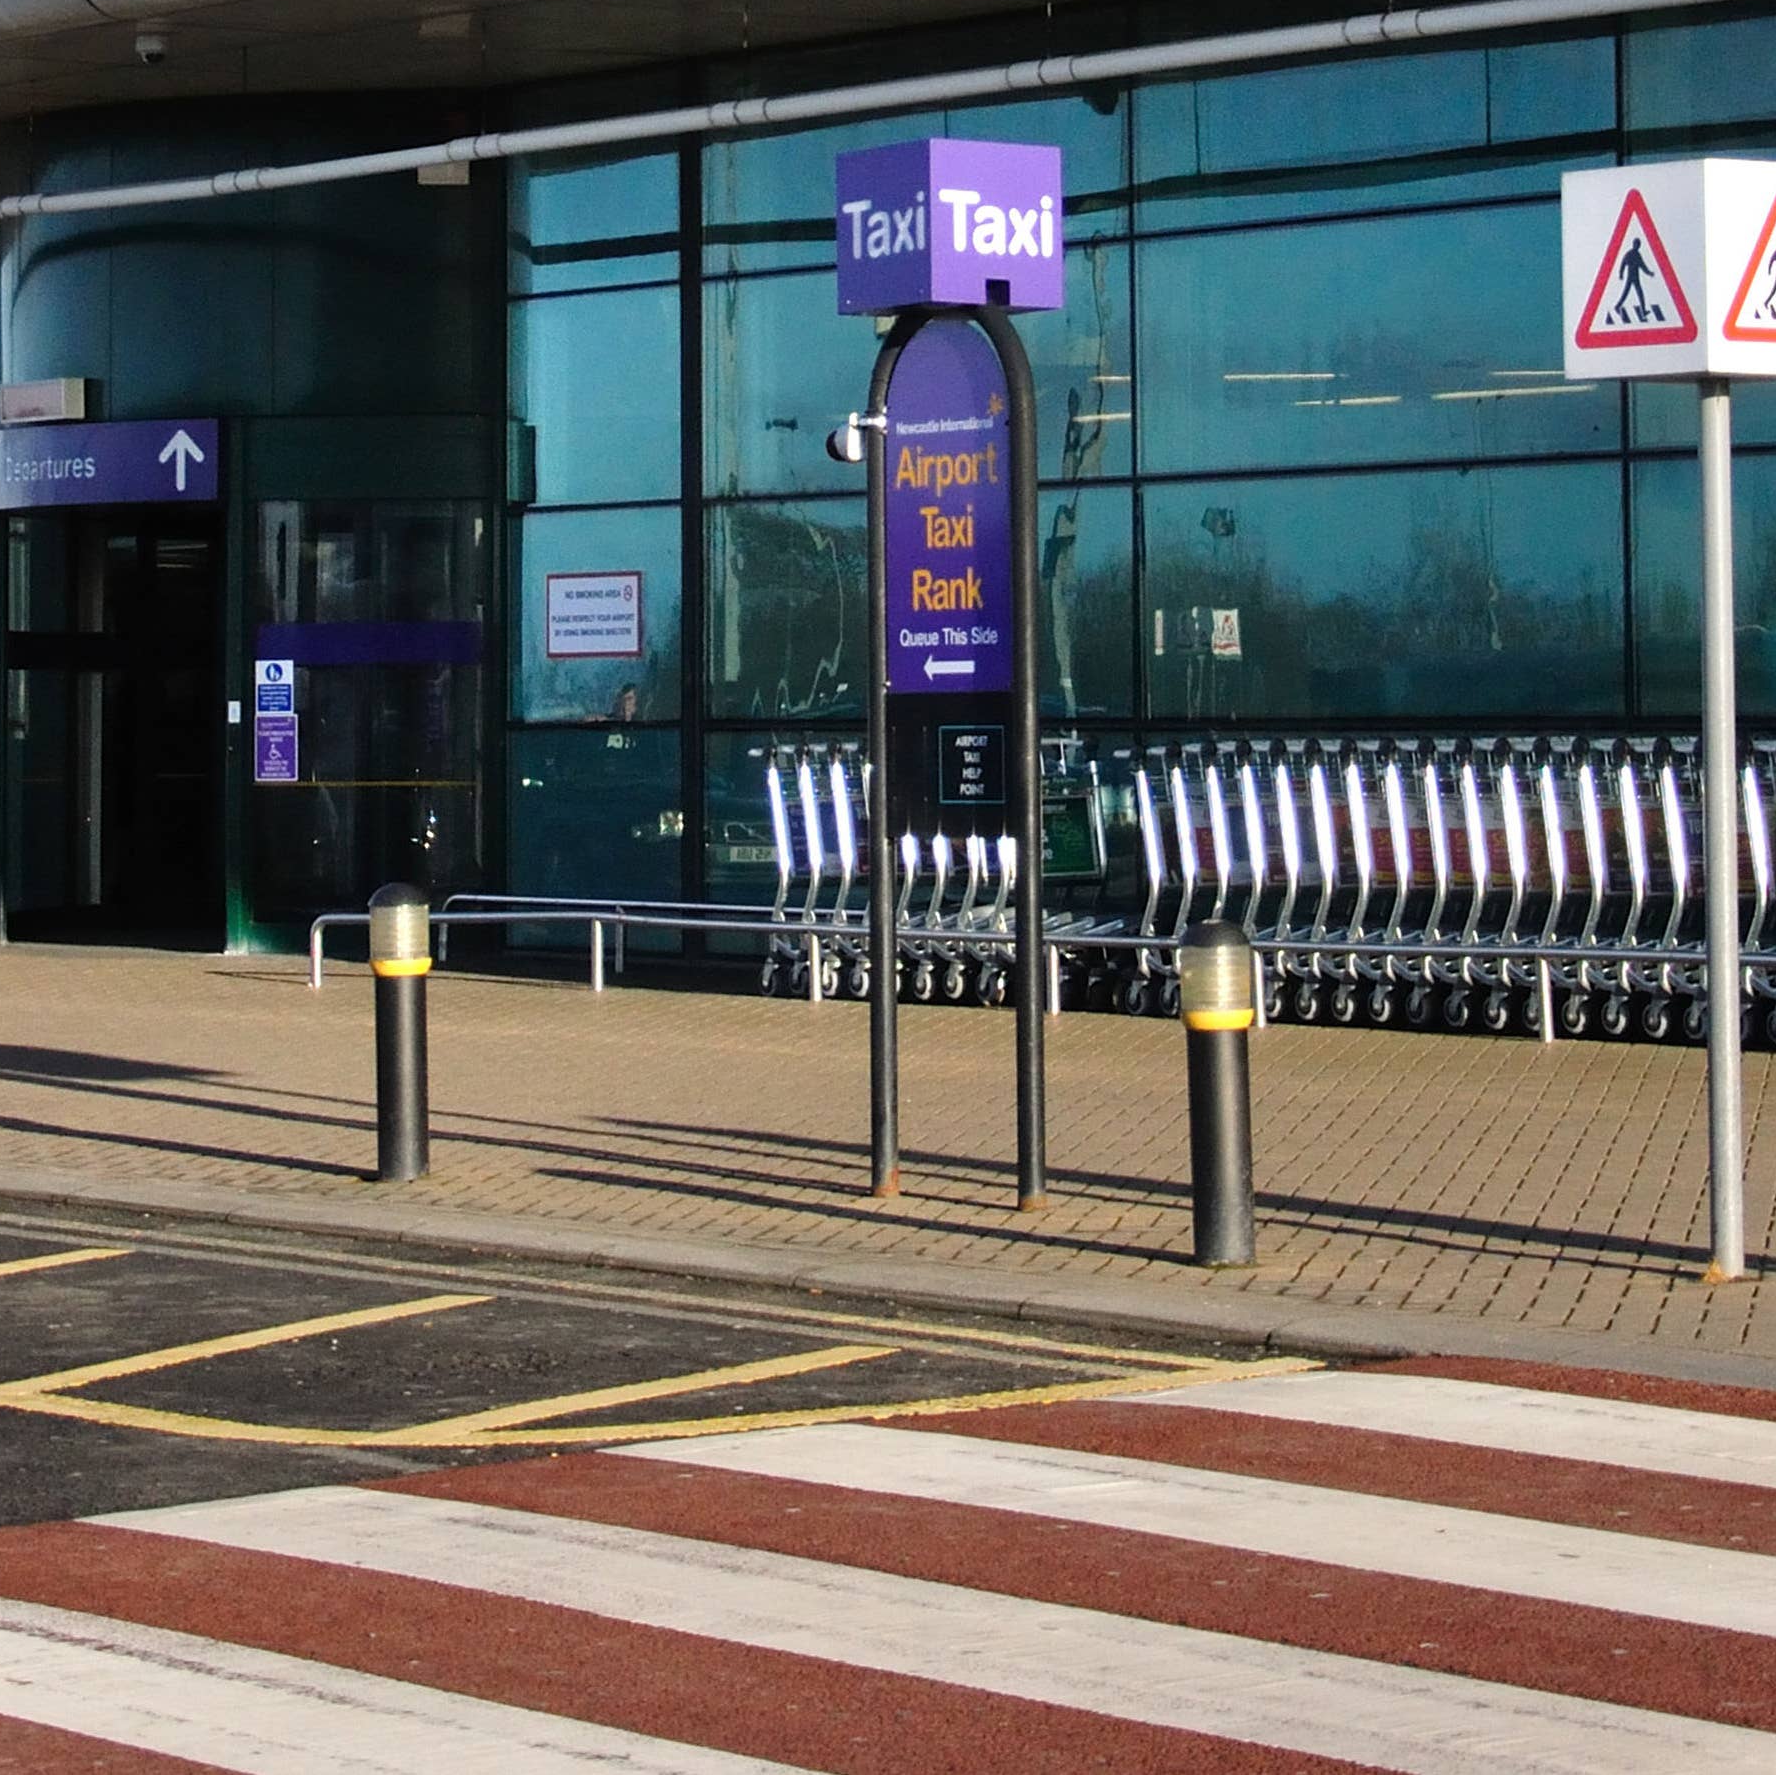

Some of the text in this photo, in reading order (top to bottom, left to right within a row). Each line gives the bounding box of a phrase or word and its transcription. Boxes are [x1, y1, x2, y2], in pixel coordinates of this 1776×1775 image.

[842, 190, 925, 260] Taxi
[938, 188, 1054, 258] Taxi
[5, 455, 96, 483] Departures
[895, 441, 998, 498] Airport
[919, 504, 974, 549] Taxi
[913, 566, 983, 612] Rank
[900, 626, 998, 647] Queue This Side
[955, 735, 988, 747] AIRPORT
